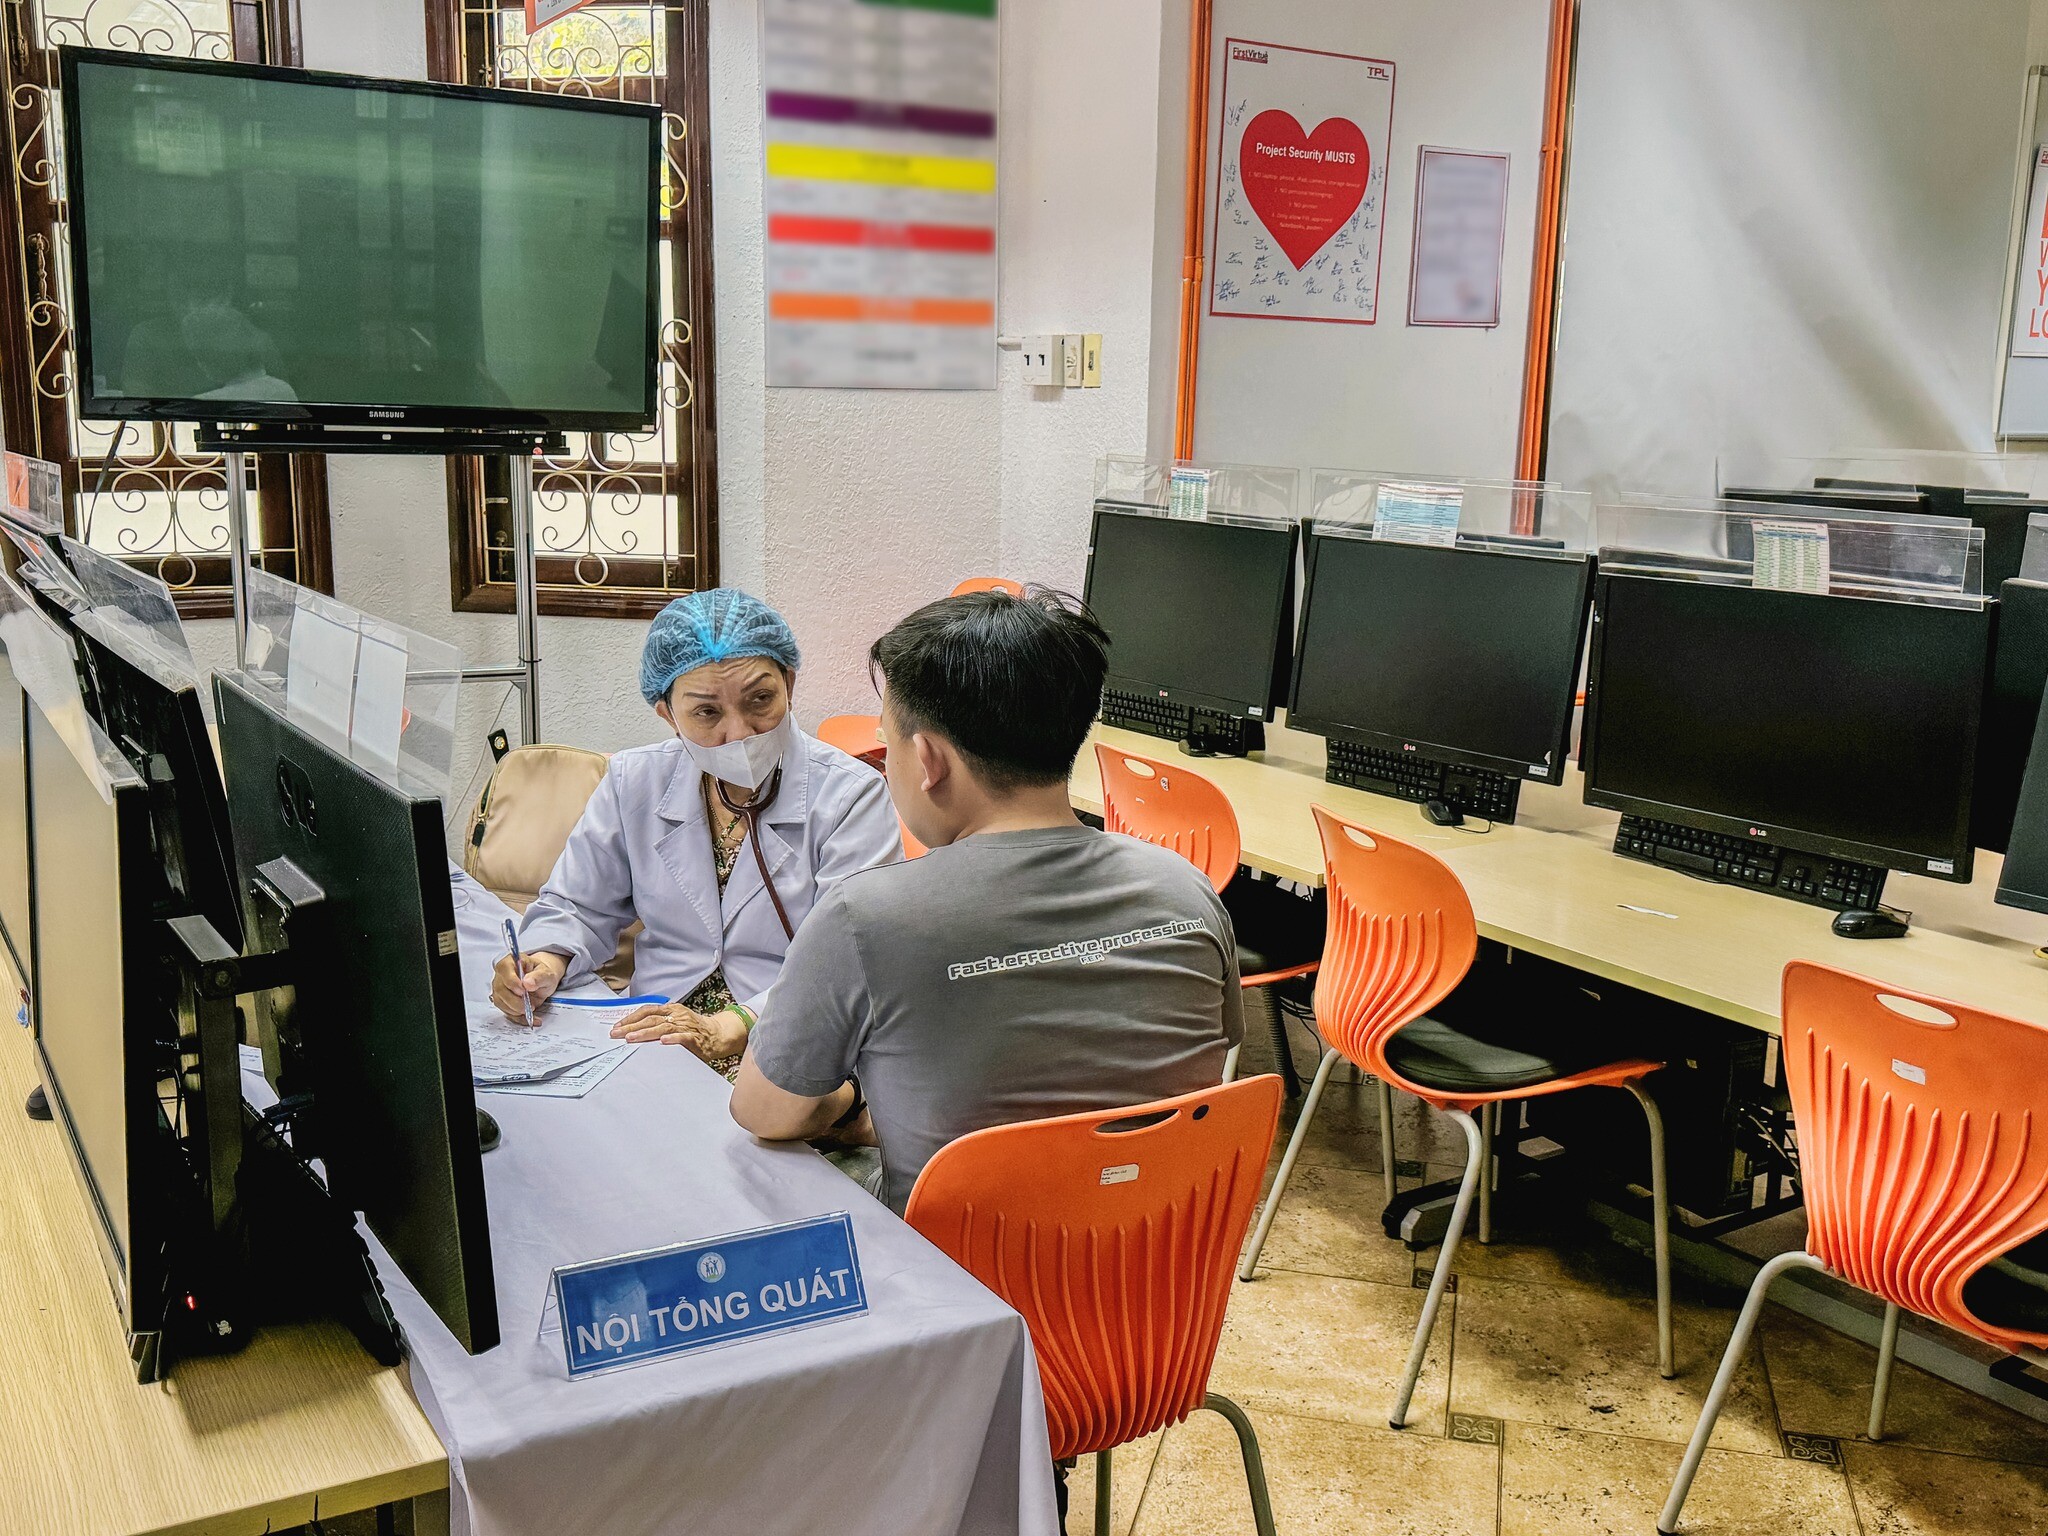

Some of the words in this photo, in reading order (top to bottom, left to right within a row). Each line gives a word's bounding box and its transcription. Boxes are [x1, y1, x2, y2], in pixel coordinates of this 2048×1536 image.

[1367, 66, 1389, 78] TPL
[1256, 142, 1287, 158] Project
[1288, 146, 1324, 163] Security
[1325, 150, 1356, 164] MUSTS
[369, 410, 405, 419] SAMSUNG
[575, 1312, 641, 1355] NỘI
[649, 1291, 750, 1337] TỔNG
[759, 1267, 850, 1314] QUÁT
